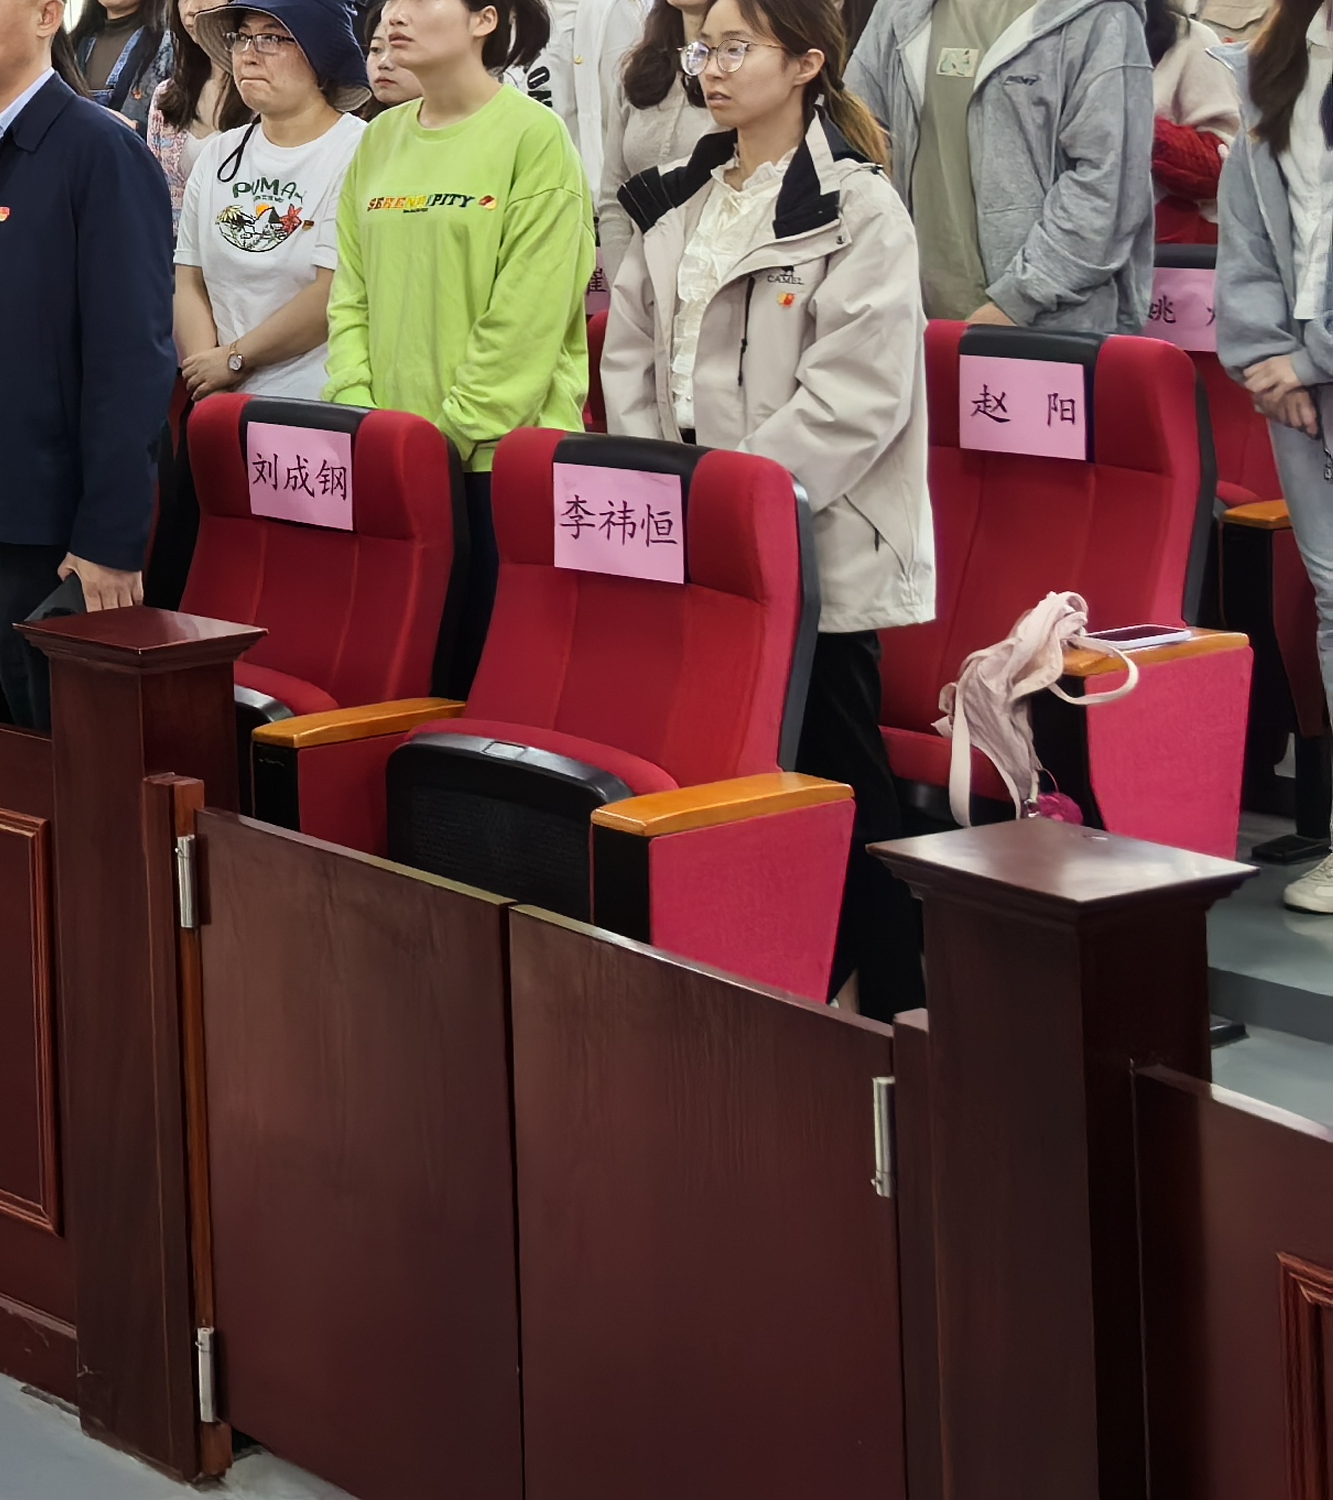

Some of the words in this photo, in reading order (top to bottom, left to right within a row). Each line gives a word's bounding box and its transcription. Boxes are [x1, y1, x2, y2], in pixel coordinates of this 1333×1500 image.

[232, 177, 297, 199] PUMA
[252, 452, 347, 501] 刘成钢
